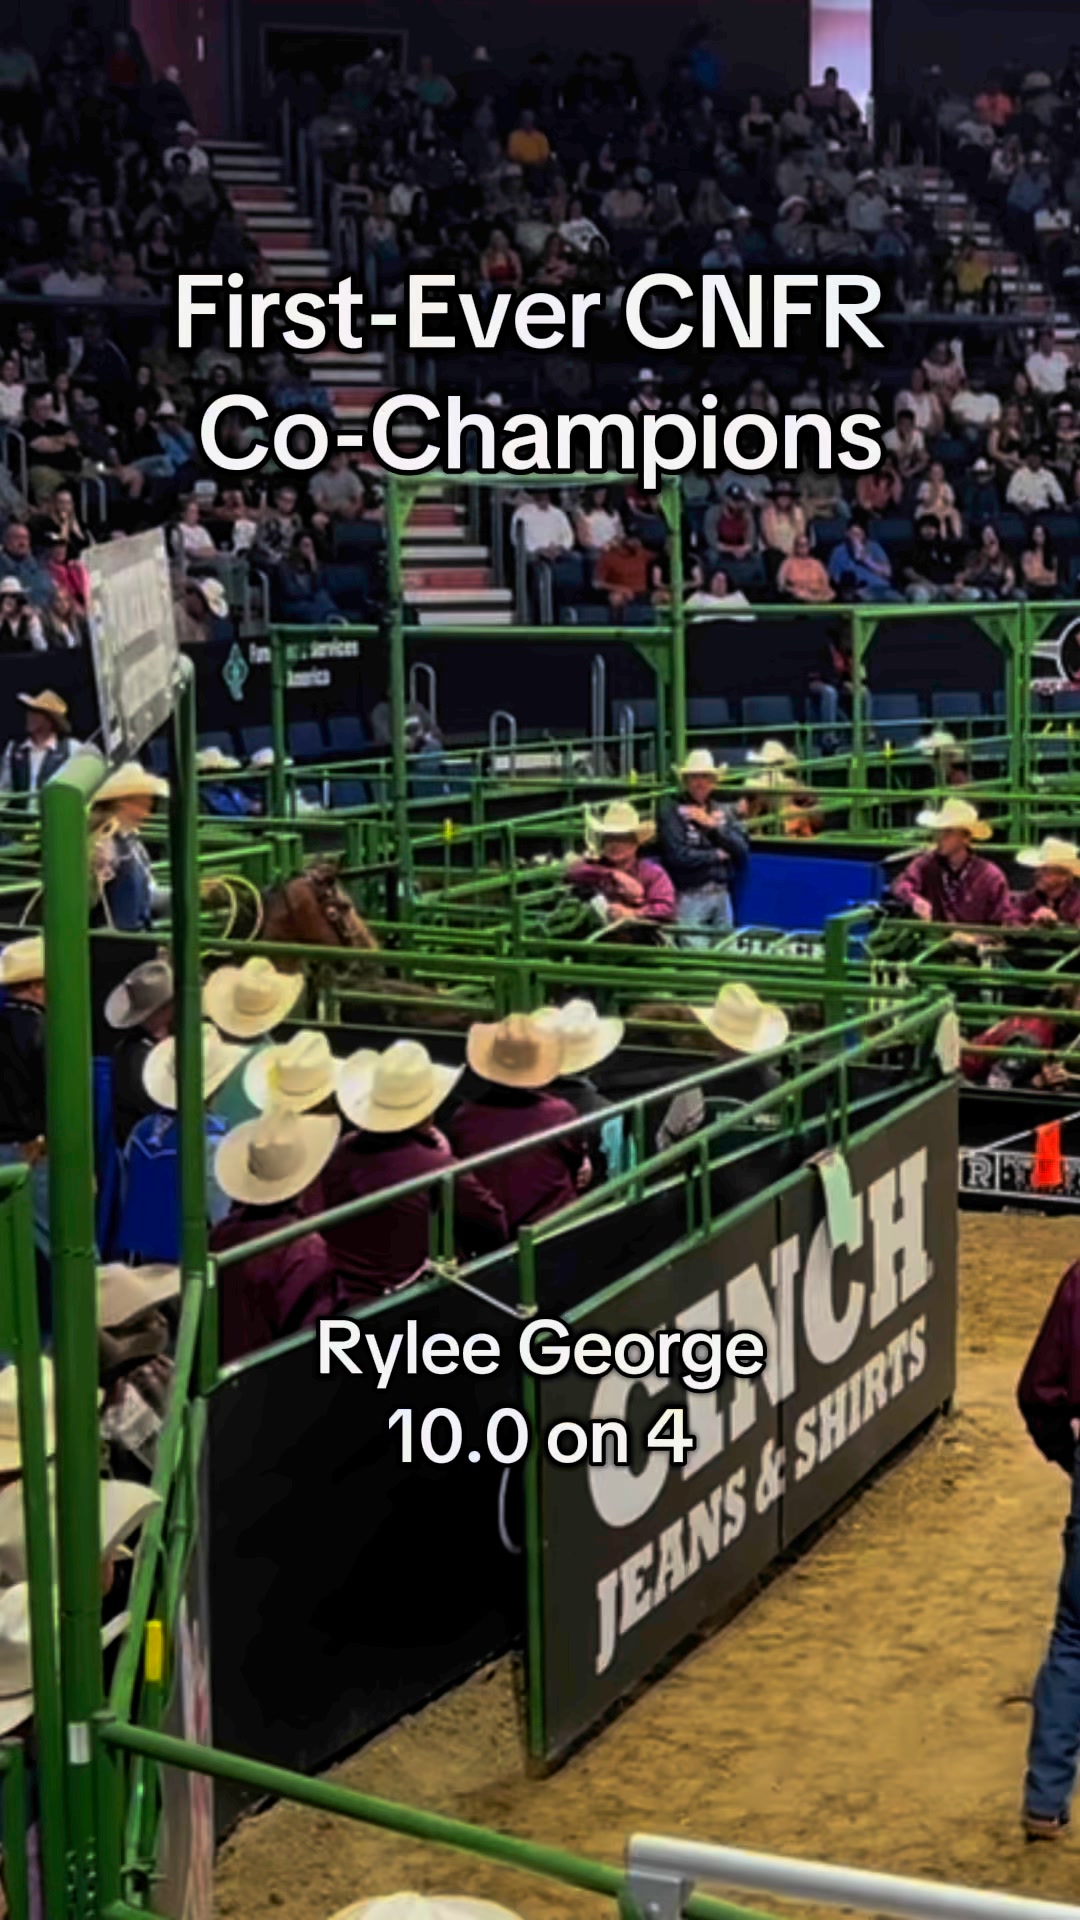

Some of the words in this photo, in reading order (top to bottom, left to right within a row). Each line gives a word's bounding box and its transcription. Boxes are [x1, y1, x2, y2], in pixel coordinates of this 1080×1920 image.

[588, 1147, 931, 1528] CINCH
[595, 1467, 747, 1675] JEANS
[755, 1437, 787, 1514] &
[795, 1313, 928, 1482] SHIRTS
